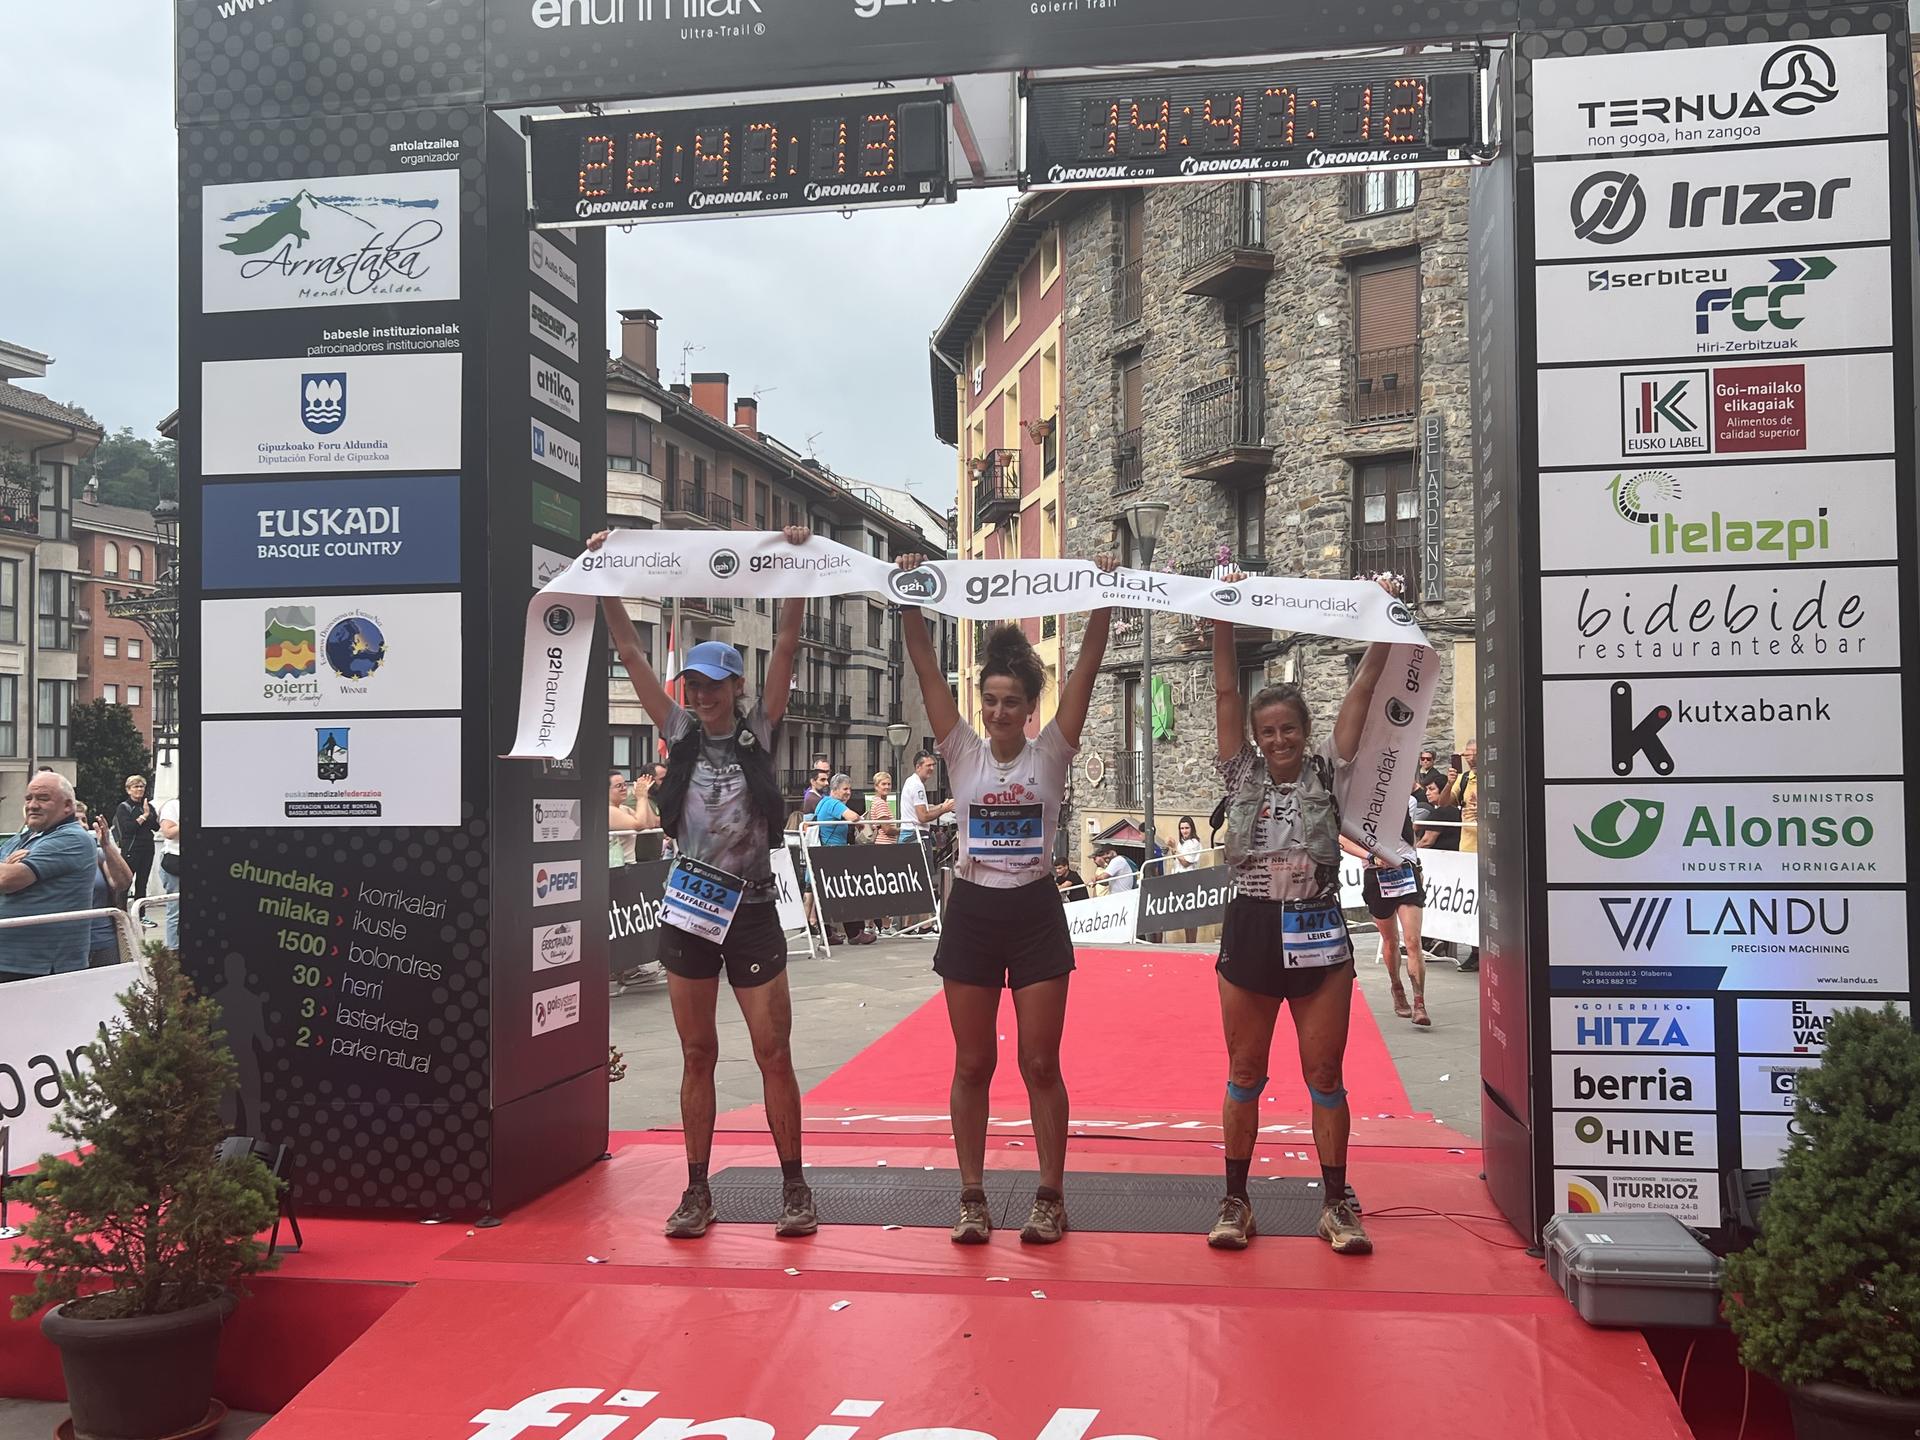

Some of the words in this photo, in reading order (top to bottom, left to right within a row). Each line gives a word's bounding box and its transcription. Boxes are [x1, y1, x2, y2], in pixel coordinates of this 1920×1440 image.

[680, 24, 750, 40] Ultra-Trail
[1578, 91, 1771, 129] TERNUA
[389, 138, 460, 152] antolatzailea
[1588, 134, 1615, 147] non
[1620, 132, 1670, 149] gogoa,
[1675, 128, 1702, 142] han
[1707, 125, 1761, 142] zangoa
[400, 151, 460, 165] organizador
[1669, 177, 1852, 229] Irizar
[240, 219, 443, 294] Arrastaka
[299, 288, 345, 299] Mendi
[372, 284, 423, 295] taldea
[1696, 282, 1806, 335] FCC
[323, 328, 370, 340] babesle
[372, 323, 460, 337] instituzionalak
[307, 341, 384, 357] patrocinadores
[386, 338, 460, 351] institucionales
[1696, 338, 1798, 353] Hiri-Zerbitzuak
[1716, 381, 1802, 397] Goi-mailako
[1724, 398, 1795, 414] elikagaiak
[1727, 415, 1777, 428] Alimentos
[1780, 415, 1793, 426] de
[1628, 438, 1666, 451] EUSKO
[1670, 436, 1705, 449] LABEL
[1720, 429, 1757, 440] calidad
[1759, 427, 1801, 441] superior
[257, 441, 315, 453] Gipuzkoako
[318, 441, 341, 451] Foru
[343, 439, 388, 450] Aldundia
[549, 441, 580, 469] MOYUA
[258, 453, 306, 465] Diputación
[308, 453, 332, 463] Foral
[334, 453, 345, 462] de
[347, 453, 389, 464] Gipuzkoa
[1426, 418, 1440, 600] BELARDENDA
[257, 506, 401, 538] EUSKADI
[1650, 507, 1829, 561] itelazpi
[257, 544, 320, 559] BASQUE
[324, 540, 403, 556] COUNTRY
[581, 552, 682, 572] g2haundiak
[749, 553, 851, 573] g2haundiak
[899, 578, 925, 593] g2h
[965, 569, 1170, 605] g2haundiak
[1251, 593, 1359, 614] g2haundiak
[1577, 579, 1865, 638] bidebide
[263, 680, 318, 699] goierri
[536, 647, 564, 749] g2haundiak
[1678, 697, 1831, 723] kutxabank
[1362, 747, 1399, 836] 2haundiak
[1772, 793, 1875, 803] SUMINISTROS
[981, 820, 1033, 836] 1434
[1682, 806, 1874, 848] Alonso
[992, 839, 1021, 847] OLATZ
[1682, 862, 1763, 872] INDUSTRIA
[1781, 861, 1877, 872] HORNIGAIAK
[229, 860, 335, 898] ehundaka
[549, 871, 578, 892] PEPSI
[681, 874, 728, 905] 1432
[820, 863, 923, 899] kutxabank
[358, 881, 448, 919] korrikalari
[675, 891, 720, 915] RAFFAELLA
[258, 897, 330, 926] milaka
[1686, 897, 1849, 936] LANDU
[352, 910, 407, 941] ikusle
[1307, 931, 1333, 941] LEIRE
[276, 929, 327, 957] 1500
[1731, 944, 1786, 954] PRECISION
[1788, 944, 1850, 954] MACHINING
[348, 941, 443, 981] bolondres
[292, 964, 320, 987] 30
[341, 972, 384, 1000] herri
[1816, 976, 1879, 985] www.landu.es
[301, 997, 315, 1018] 3
[1582, 1003, 1684, 1011] GOIERRIKO
[1792, 1001, 1813, 1015] EL
[335, 1003, 419, 1041] lasterketa
[1577, 1016, 1690, 1046] HITZA
[296, 1026, 311, 1047] 2
[330, 1037, 377, 1062] parke
[379, 1047, 432, 1074] natural
[1573, 1067, 1693, 1102] berria
[1606, 1130, 1695, 1157] HINE
[1613, 1182, 1699, 1200] ITURRIOZ
